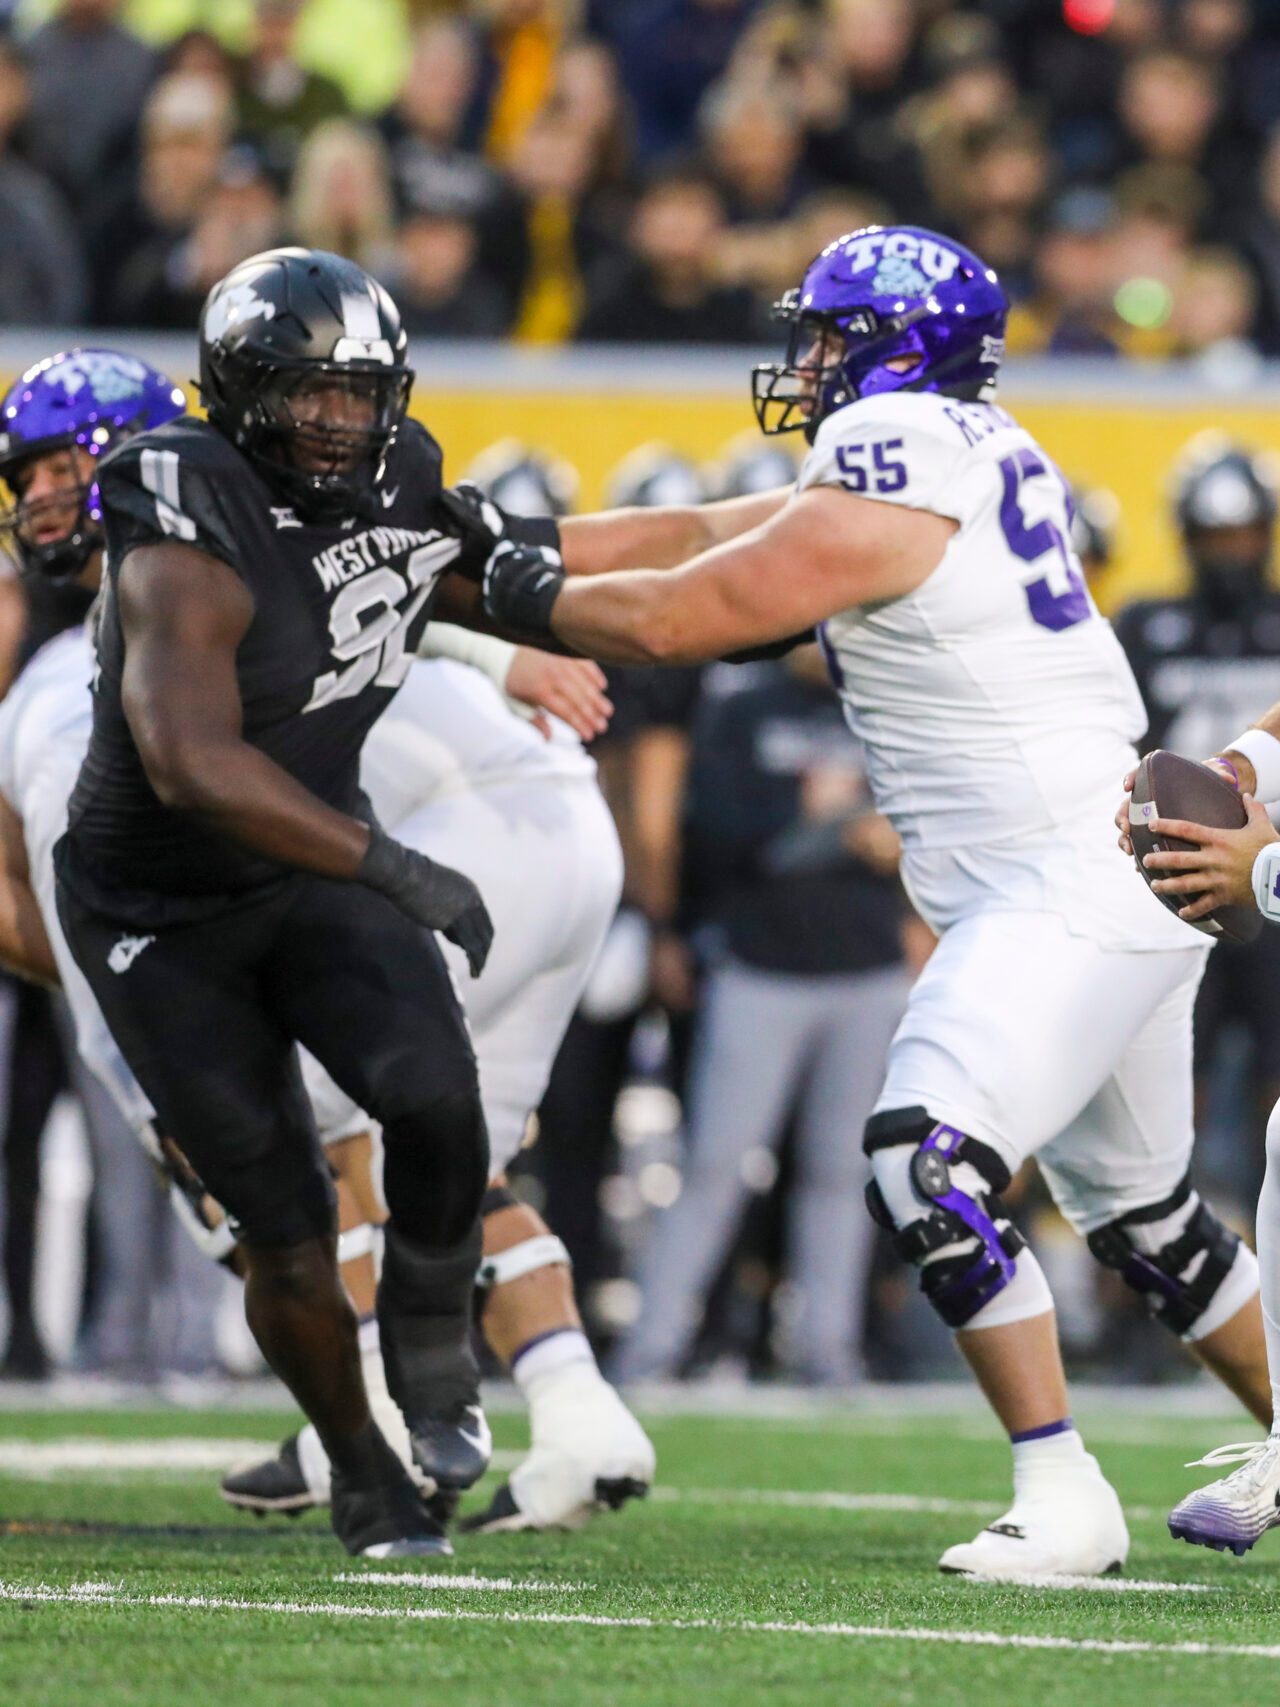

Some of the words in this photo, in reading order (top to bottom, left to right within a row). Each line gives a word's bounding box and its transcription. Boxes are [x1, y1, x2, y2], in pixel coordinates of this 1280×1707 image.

[845, 233, 960, 282] TCU
[835, 438, 908, 494] 55
[312, 531, 376, 593] WEST
[998, 448, 1092, 633] 5
